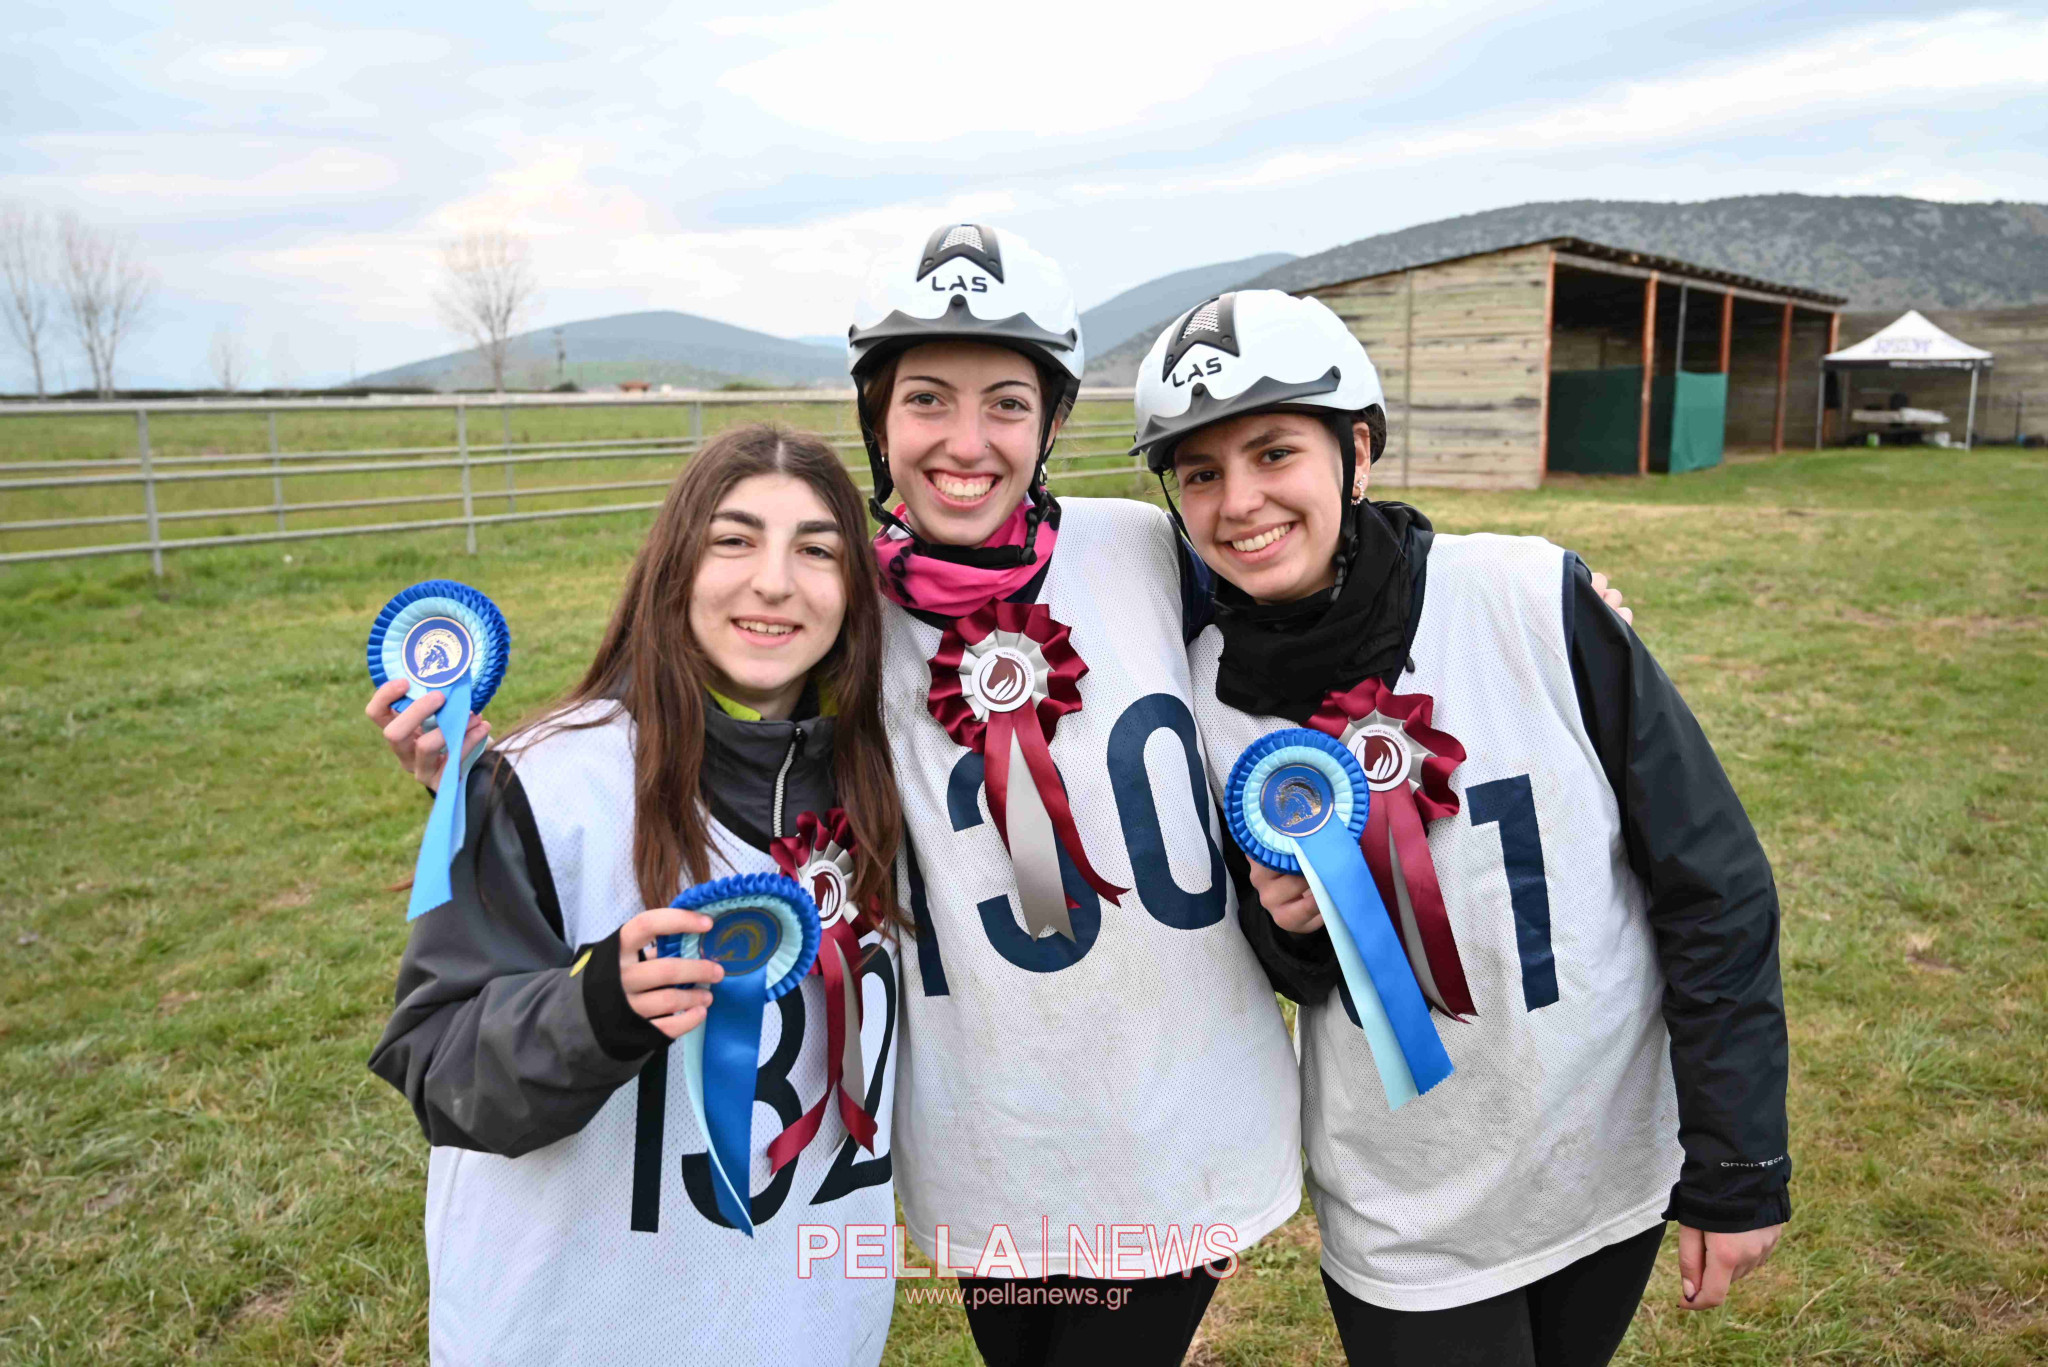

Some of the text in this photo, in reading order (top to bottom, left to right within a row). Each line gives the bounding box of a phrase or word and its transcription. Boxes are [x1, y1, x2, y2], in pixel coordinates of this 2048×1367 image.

[932, 275, 988, 293] LAS
[1171, 356, 1223, 388] LAS
[904, 692, 1228, 997] 130
[630, 942, 897, 1234] 132
[1720, 1155, 1784, 1168] OMNI-TECH
